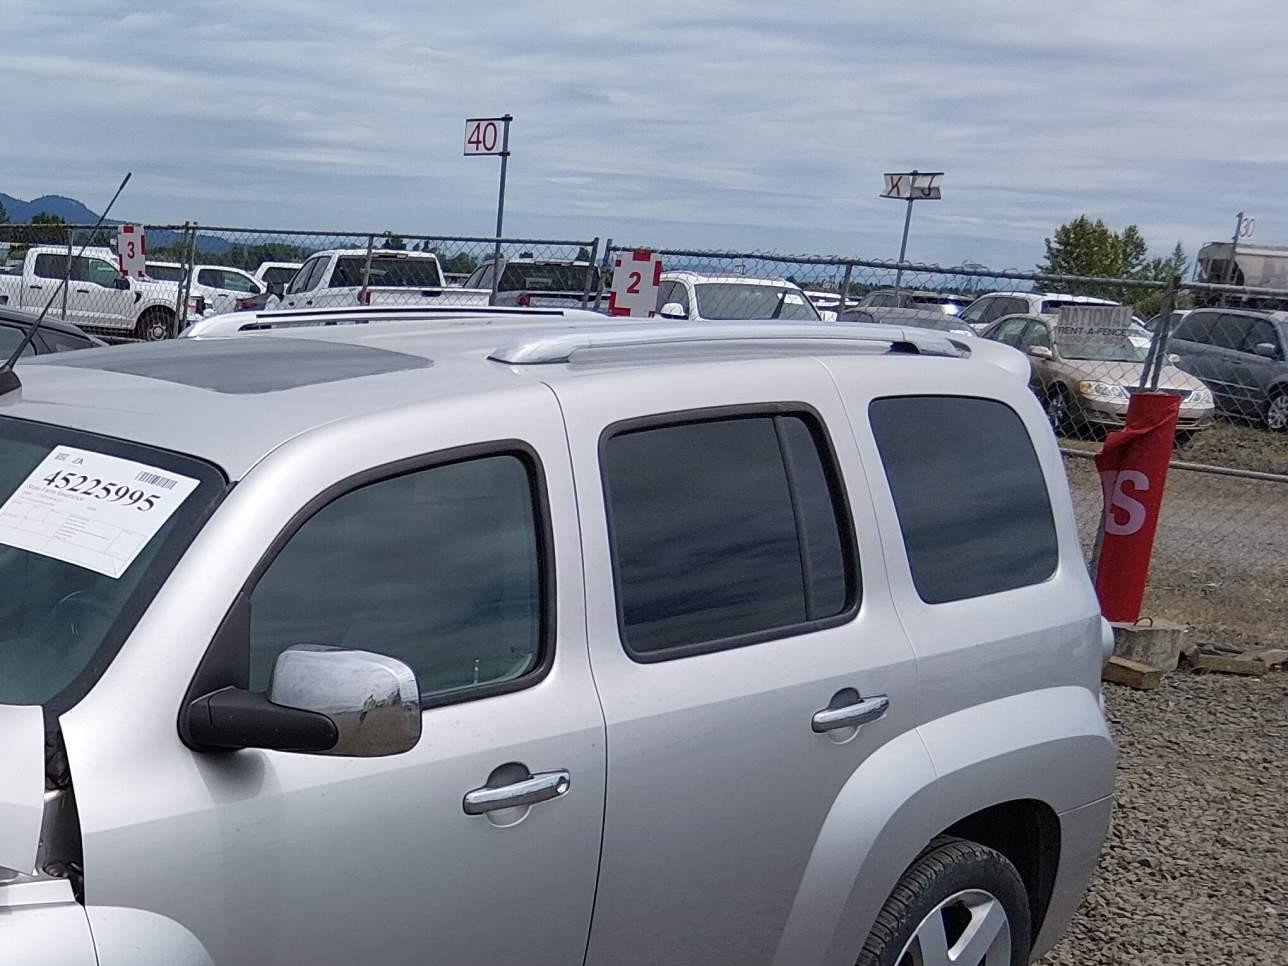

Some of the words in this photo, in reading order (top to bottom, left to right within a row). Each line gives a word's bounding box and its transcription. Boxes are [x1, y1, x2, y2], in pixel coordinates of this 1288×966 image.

[468, 122, 497, 151] 40
[127, 241, 135, 259] 3
[626, 272, 642, 294] 2
[1060, 307, 1131, 327] NATIONAL
[43, 470, 161, 512] 45225995
